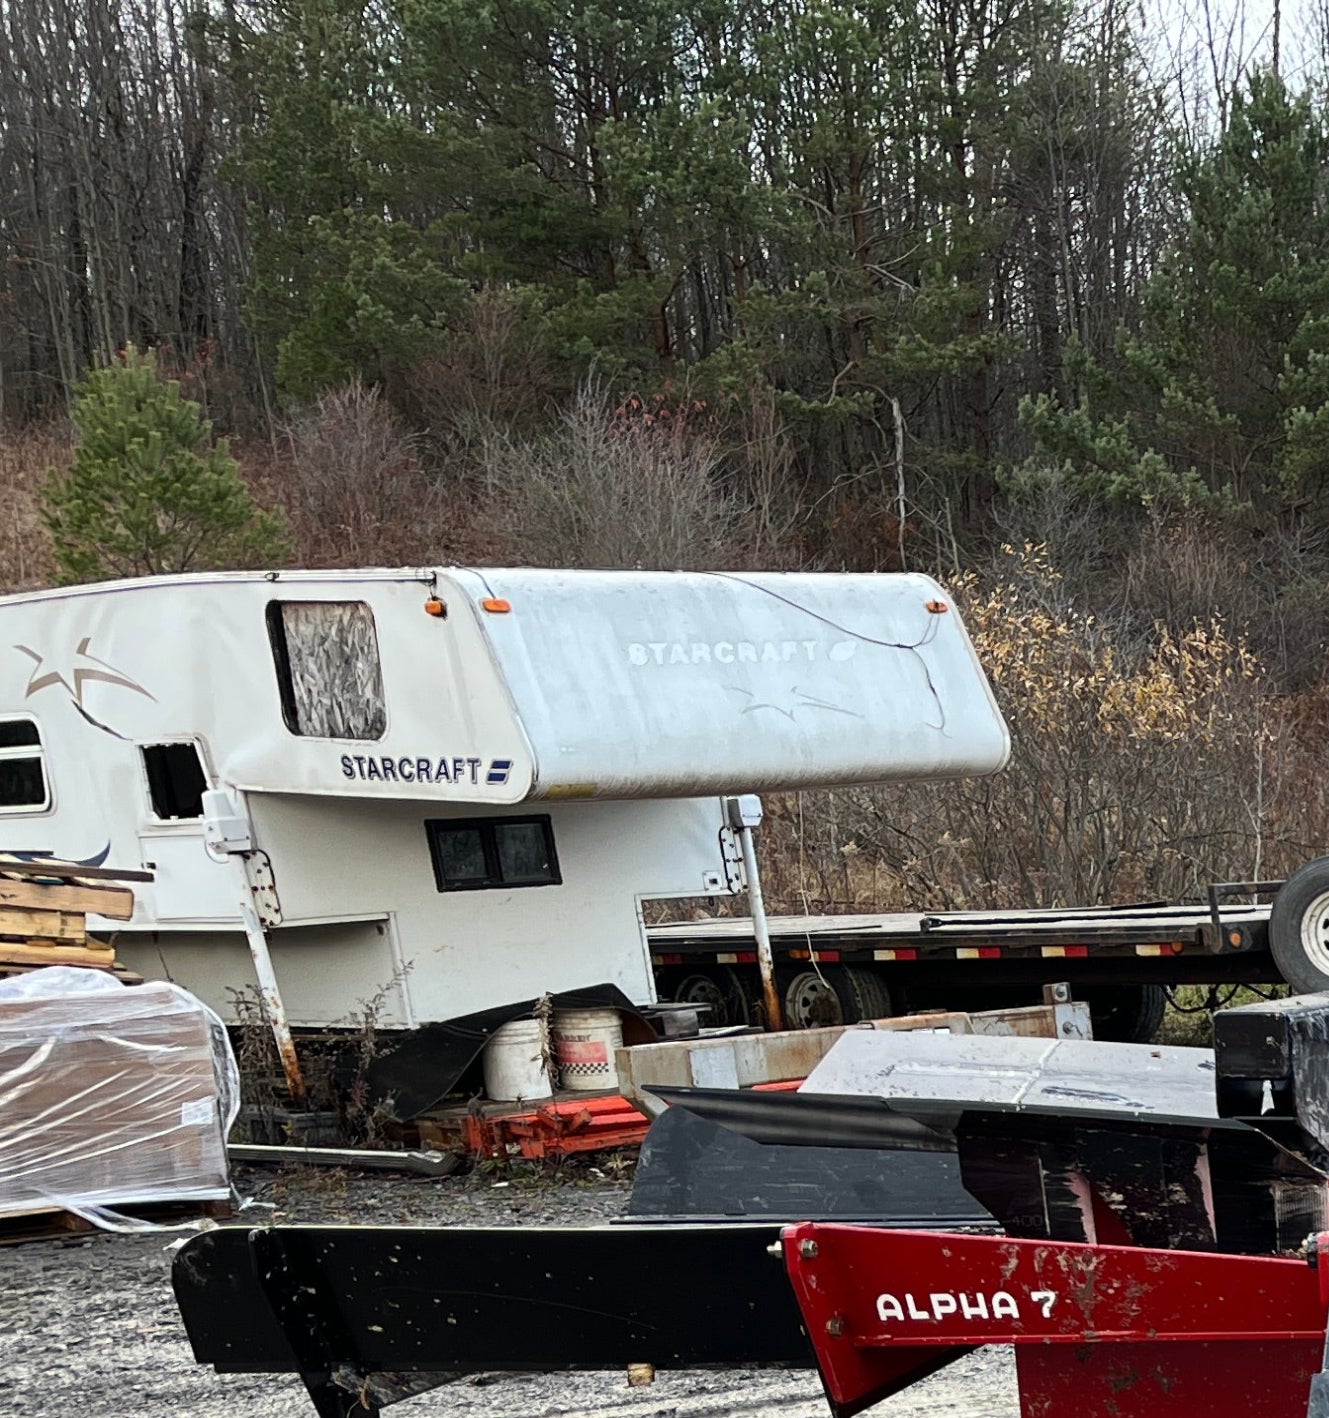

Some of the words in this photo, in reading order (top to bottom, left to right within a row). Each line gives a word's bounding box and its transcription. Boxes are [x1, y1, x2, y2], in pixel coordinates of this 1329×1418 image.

[629, 641, 817, 666] STARCRAFT
[341, 754, 482, 785] STARCRAFT
[876, 1291, 1020, 1321] ALPHA
[1030, 1291, 1056, 1319] 7
